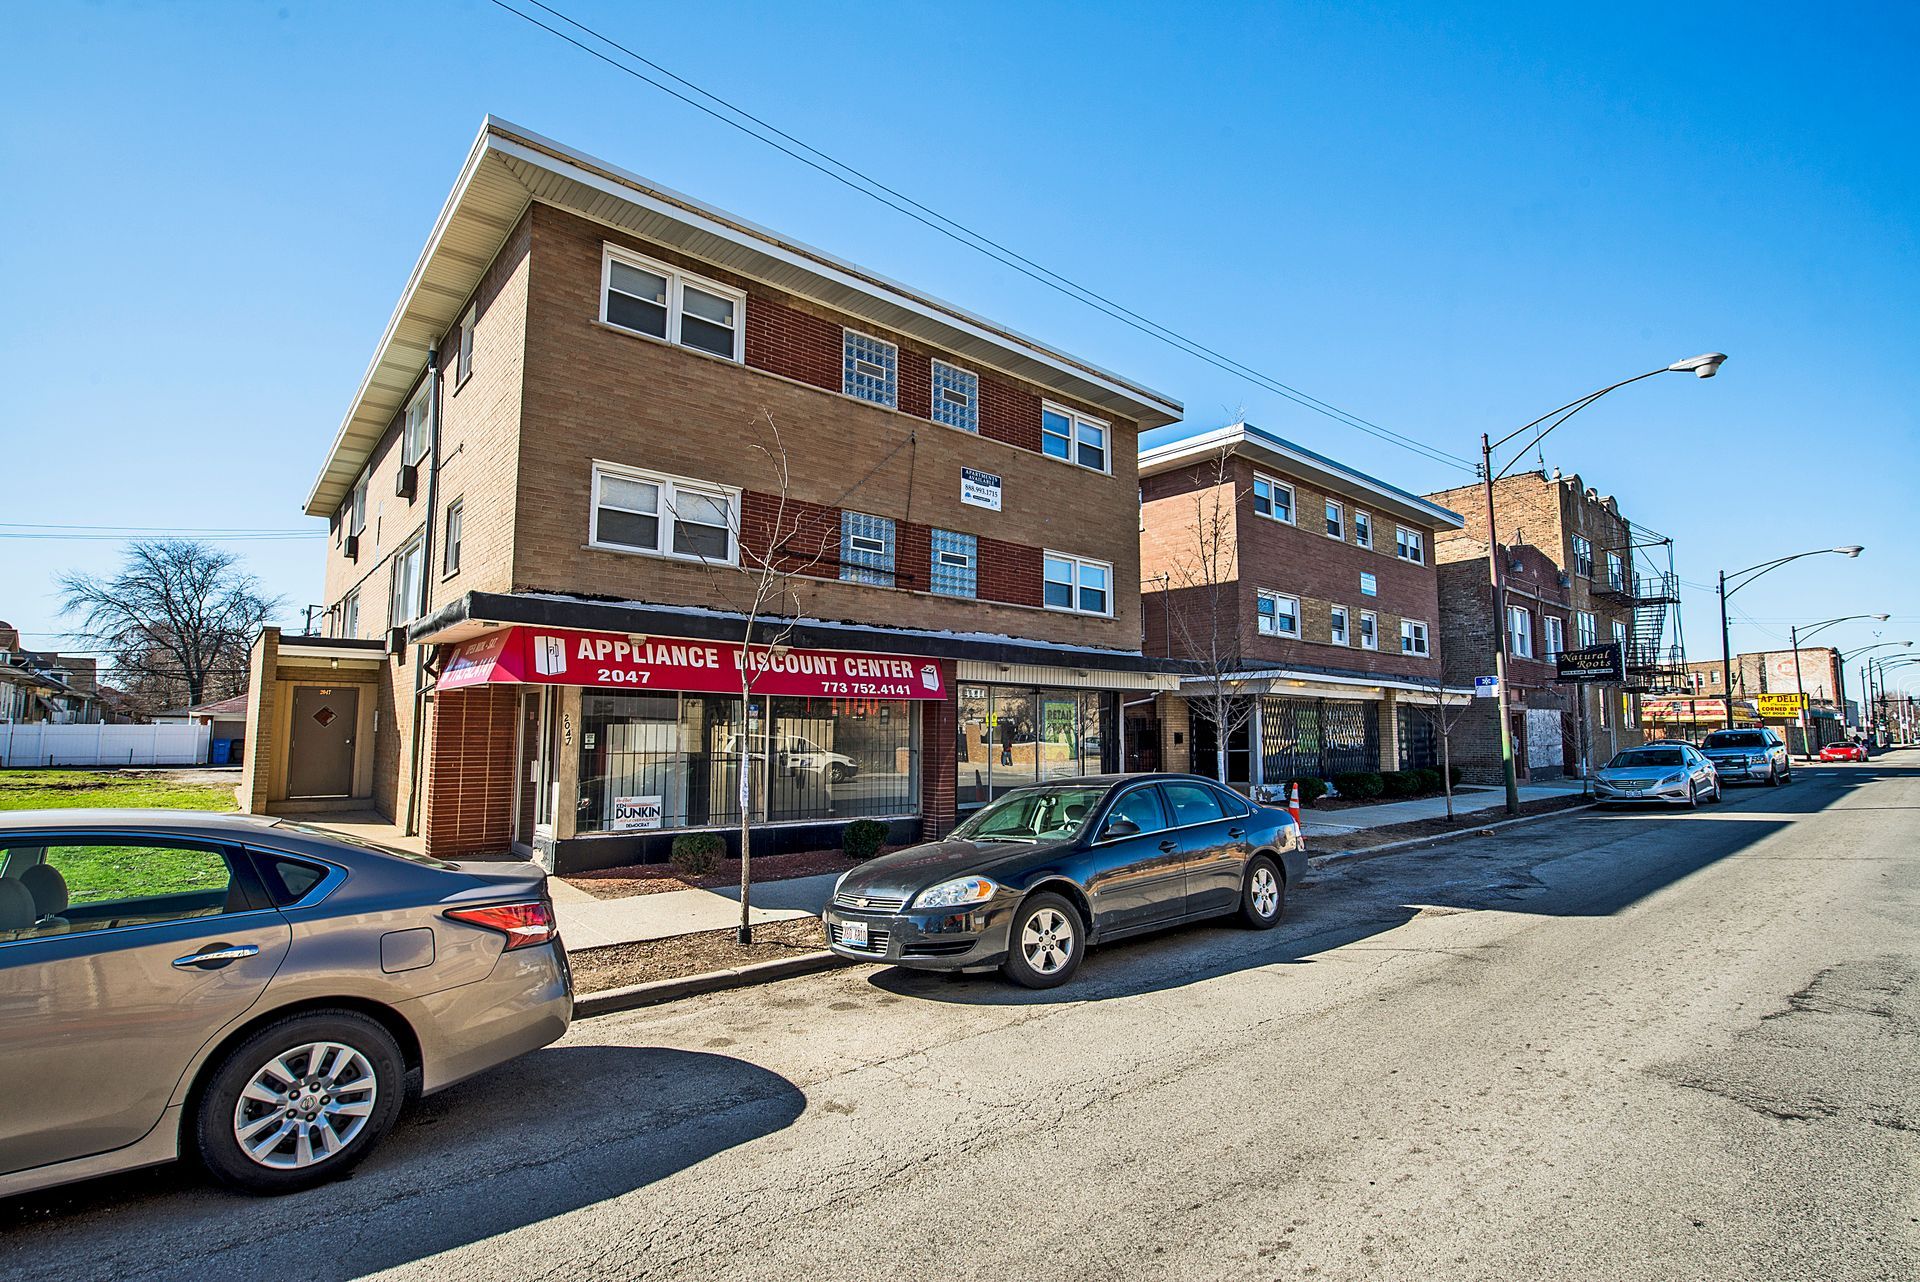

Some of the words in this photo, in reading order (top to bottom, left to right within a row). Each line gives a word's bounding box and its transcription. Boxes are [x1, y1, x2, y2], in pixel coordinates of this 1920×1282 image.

[577, 638, 720, 669] APPLIANCE
[733, 649, 838, 676] DISCOUNT
[844, 657, 915, 679] CENTER
[1561, 650, 1610, 662] Natural
[1577, 660, 1611, 670] Roots
[597, 669, 651, 684] 2047
[821, 682, 848, 693] 773
[851, 683, 911, 695] 752.4141
[1776, 695, 1799, 703] DELI
[1047, 709, 1073, 720] RETAIL
[563, 713, 572, 746] 2047
[616, 806, 661, 819] DUNKIN
